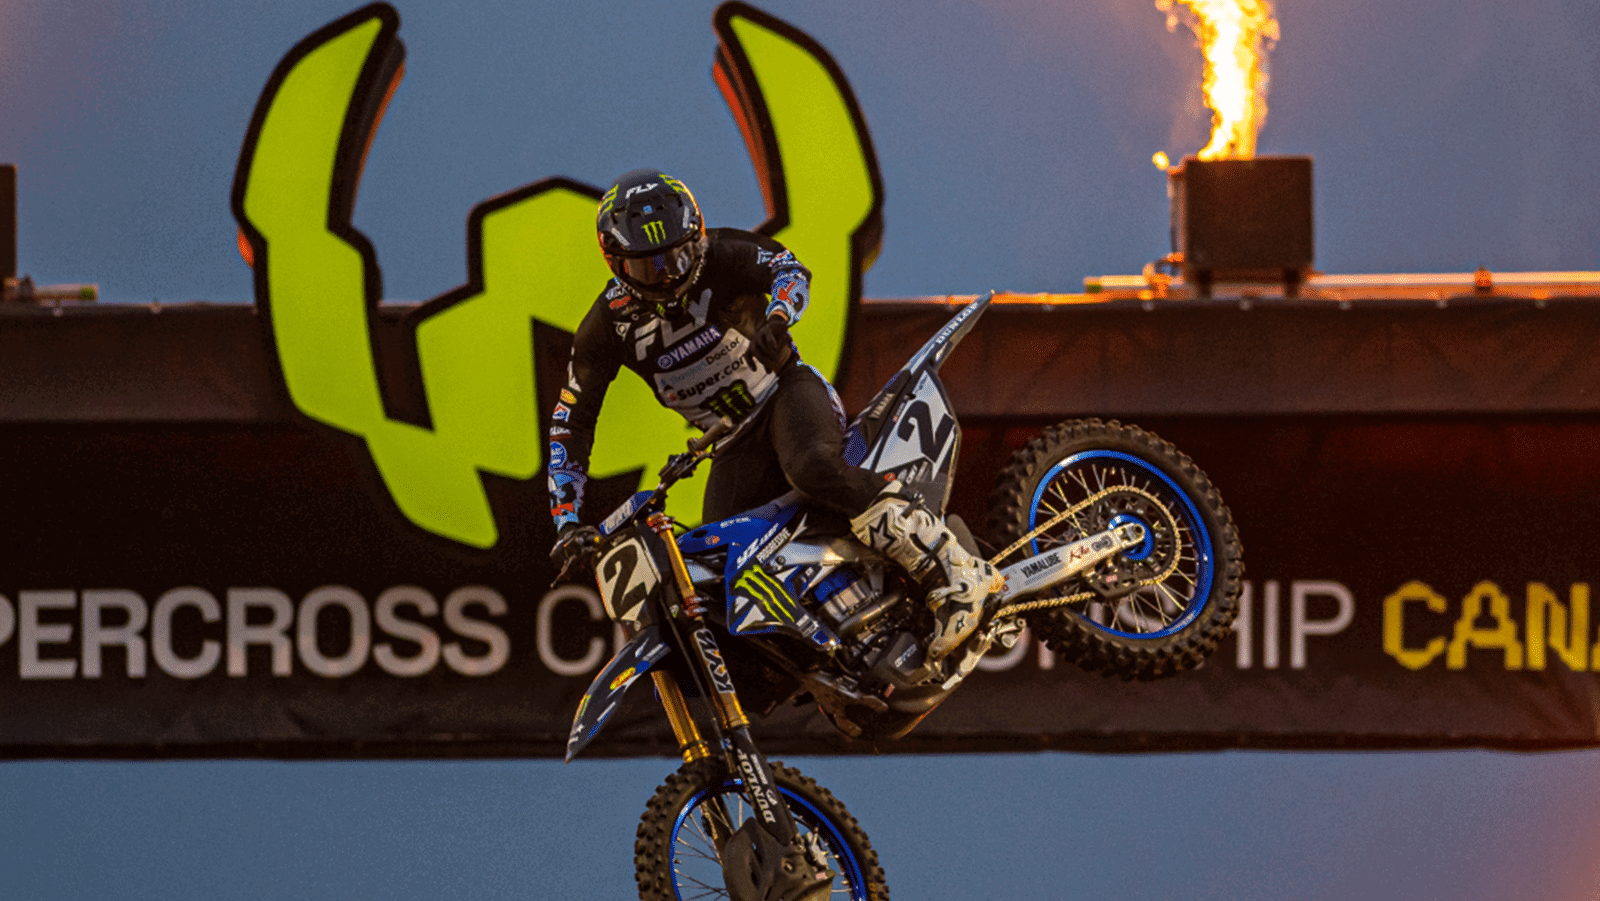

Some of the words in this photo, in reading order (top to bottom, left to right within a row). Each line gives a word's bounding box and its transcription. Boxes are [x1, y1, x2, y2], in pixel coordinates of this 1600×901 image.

[625, 183, 659, 199] FLY
[634, 288, 713, 362] FLY
[669, 326, 721, 363] YAMAHA
[897, 400, 955, 463] 2
[602, 543, 648, 621] 2
[1020, 553, 1061, 578] YAMALUBE
[0, 586, 510, 680] ERCROSS
[1383, 580, 1600, 671] CAN
[694, 628, 736, 694] KYB
[737, 749, 776, 824] DUNLOP
